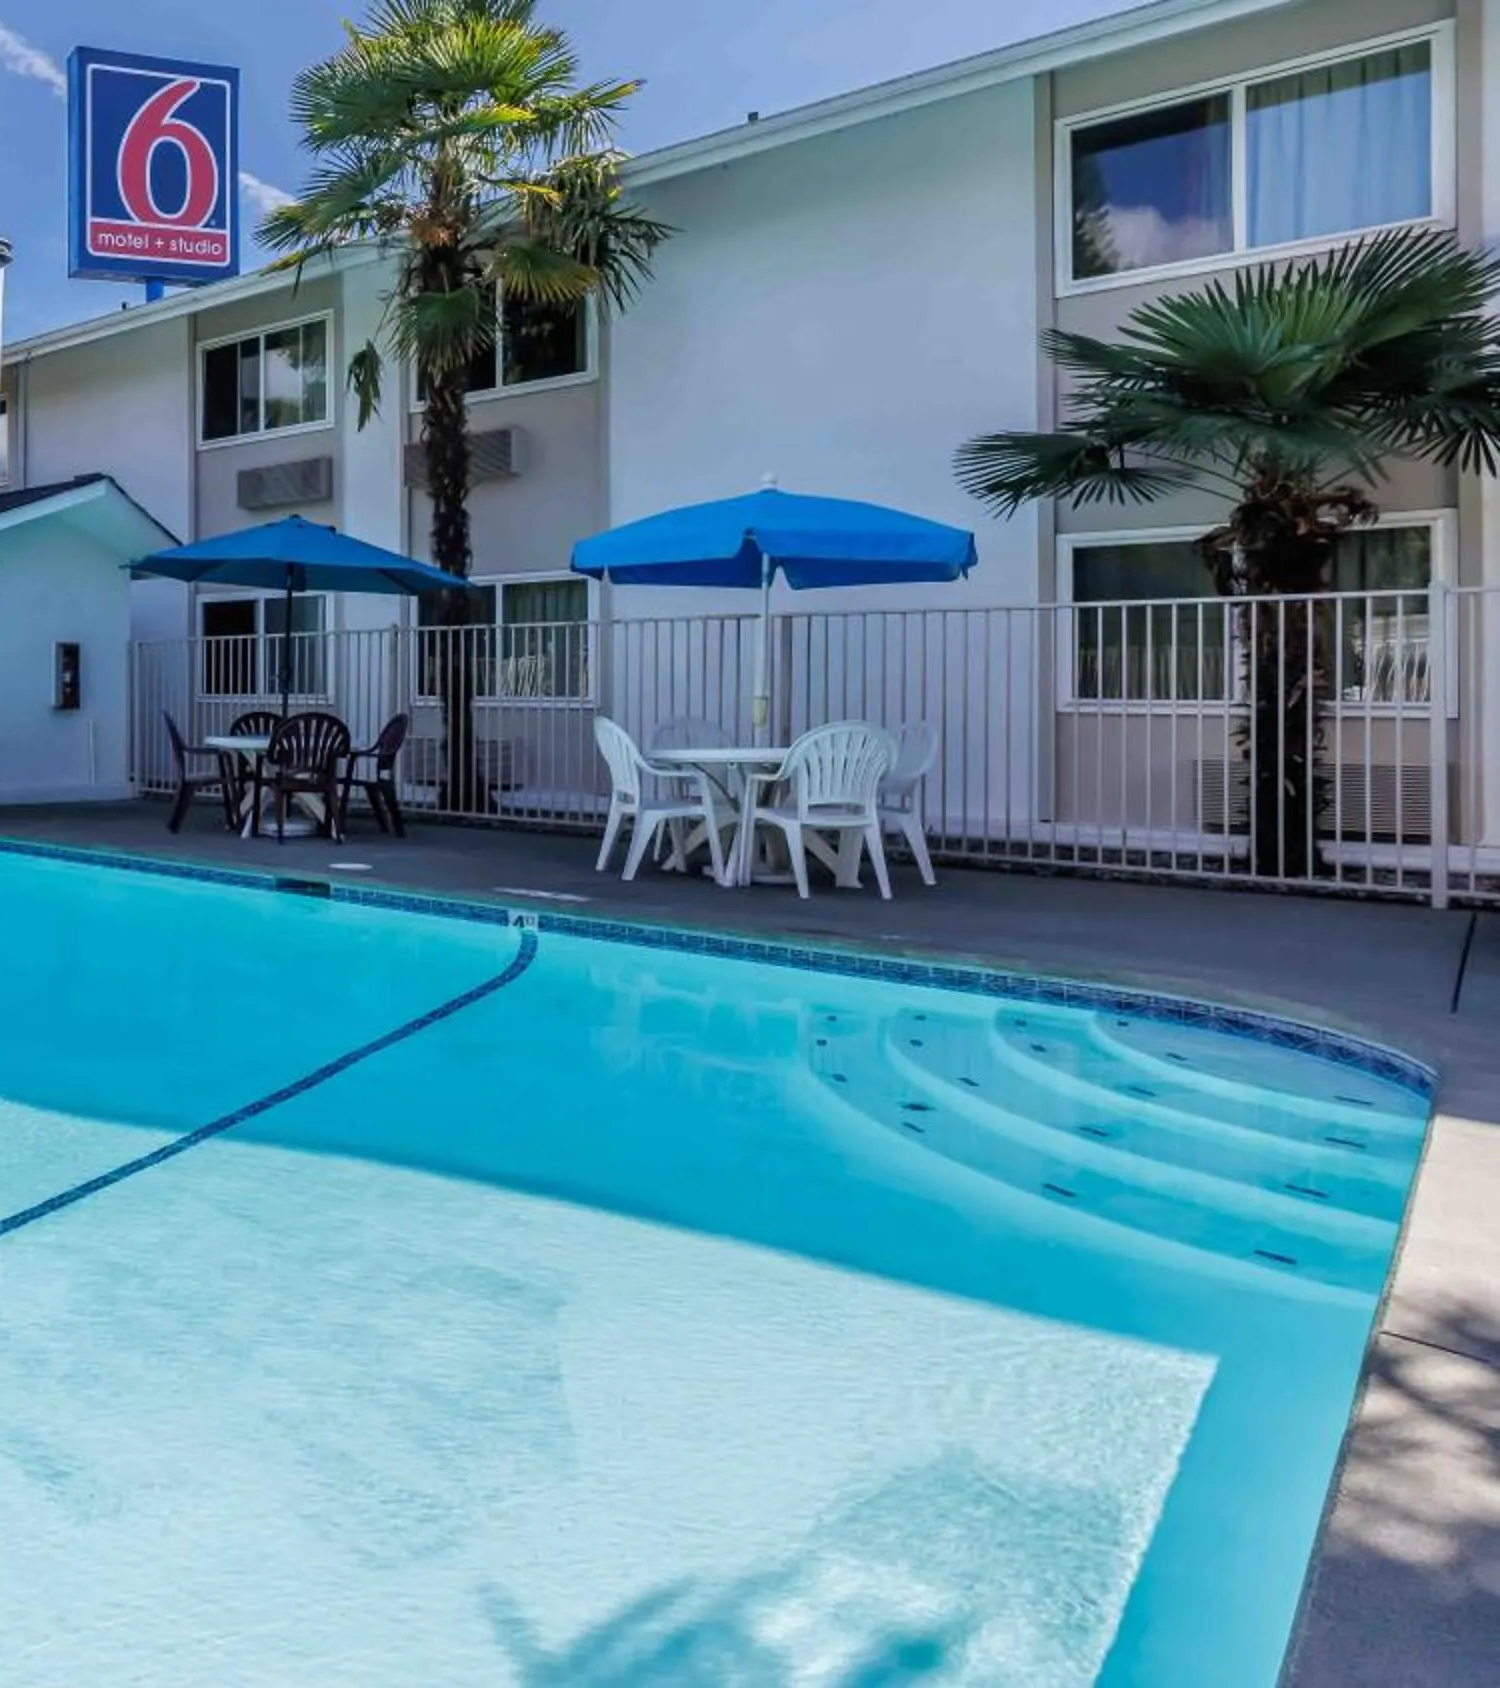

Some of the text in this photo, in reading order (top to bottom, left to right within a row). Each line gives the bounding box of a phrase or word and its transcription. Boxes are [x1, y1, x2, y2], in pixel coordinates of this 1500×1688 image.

[117, 77, 218, 228] 6
[98, 233, 149, 249] motel
[169, 238, 222, 255] studio
